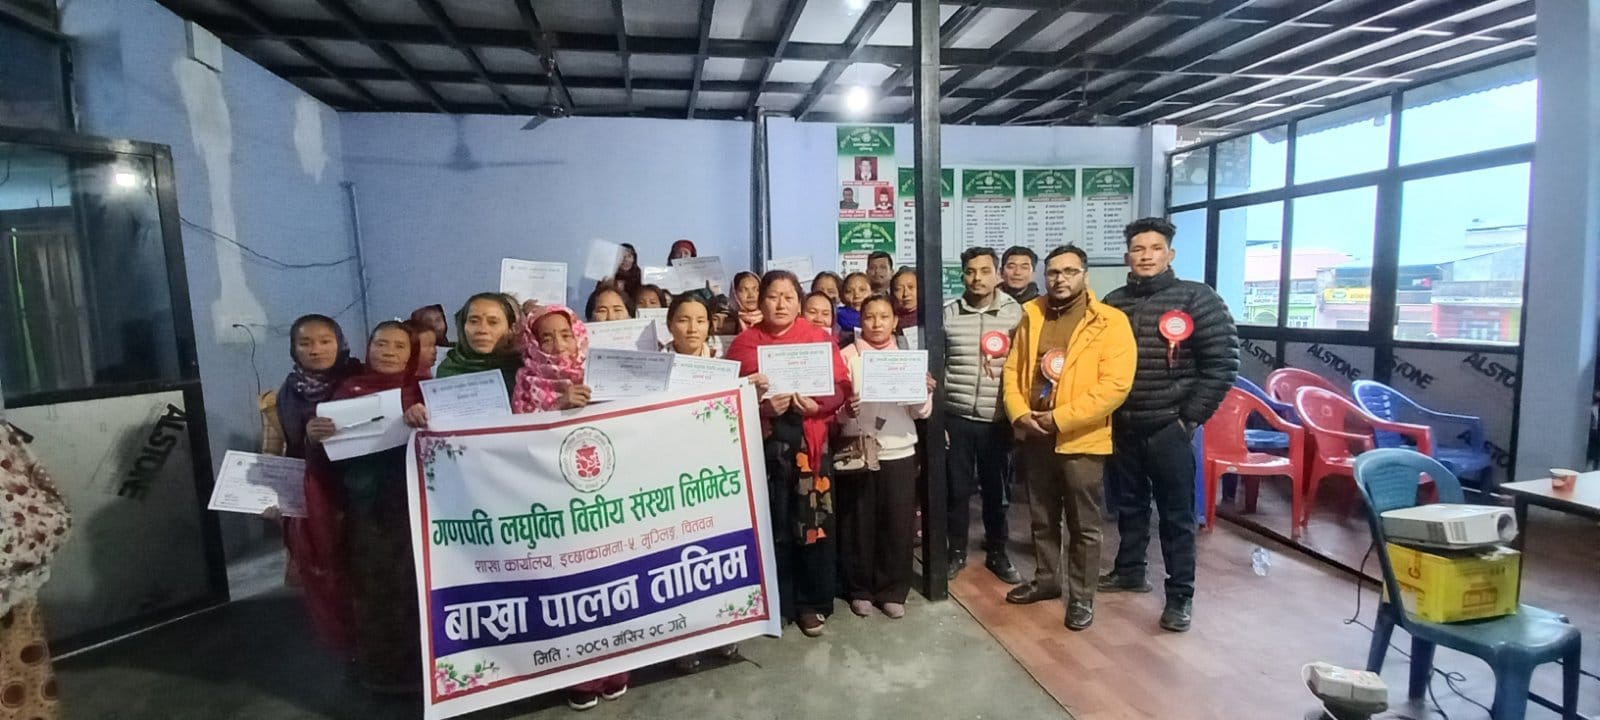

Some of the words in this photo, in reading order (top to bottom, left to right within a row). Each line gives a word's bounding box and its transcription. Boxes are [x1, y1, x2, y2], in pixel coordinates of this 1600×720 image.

[1306, 343, 1361, 380] ALSTONE
[1462, 352, 1516, 388] ALSTO
[117, 403, 191, 498] ALSTONE
[432, 508, 494, 546] गणपति
[498, 502, 565, 549] लघुवित्त
[570, 493, 625, 535] वित्तीय
[629, 487, 676, 522] संस्था
[679, 465, 741, 508] लिमिटेड
[475, 559, 500, 573] शाखा
[681, 515, 714, 535] चितवन
[443, 596, 529, 641] बाख्रा
[538, 574, 639, 628] पालन
[647, 545, 748, 604] तालिम
[533, 647, 562, 666] मिति
[575, 638, 609, 656] २०८१
[613, 628, 645, 647] मंसिर
[649, 623, 664, 637] २८
[668, 613, 687, 632] गते
